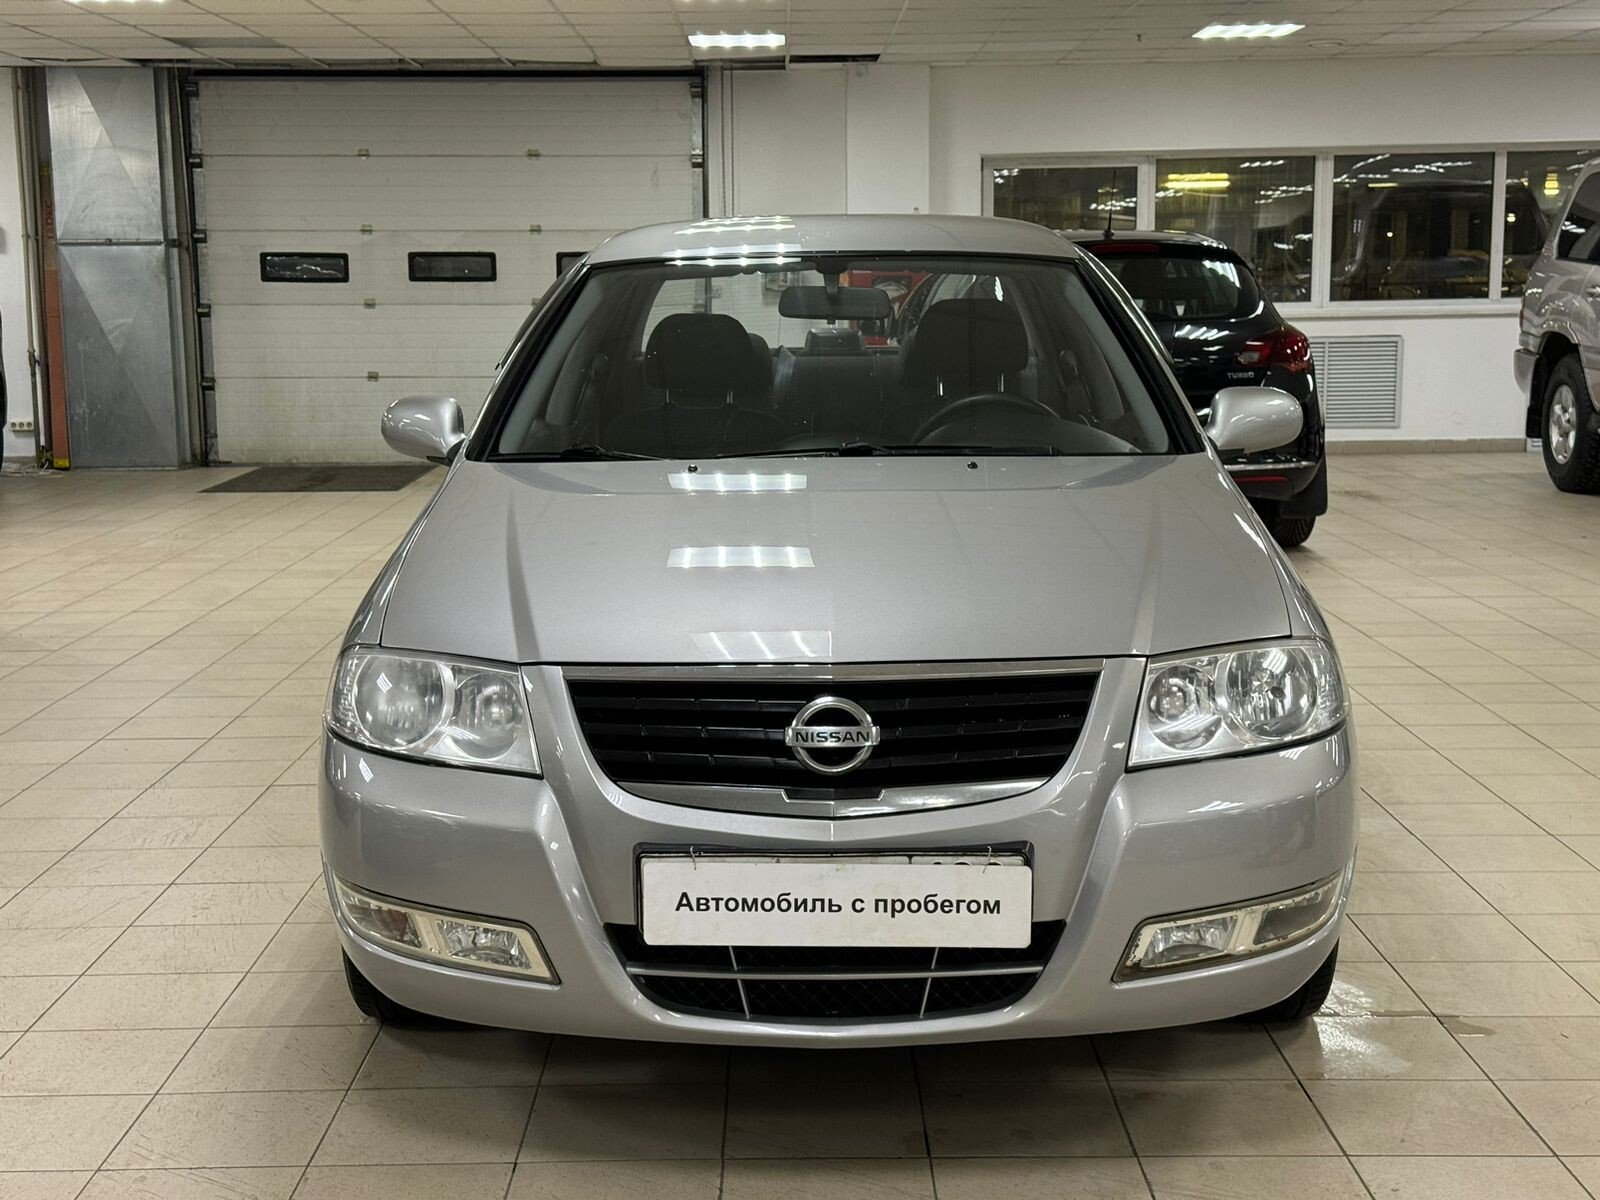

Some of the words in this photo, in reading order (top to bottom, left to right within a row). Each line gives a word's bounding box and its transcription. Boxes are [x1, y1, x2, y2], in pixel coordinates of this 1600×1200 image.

[1227, 371, 1255, 379] TURBO
[795, 731, 870, 743] NISSAN
[674, 891, 842, 914] Автомобиль
[851, 896, 866, 914] с
[874, 893, 1001, 919] пробегом
